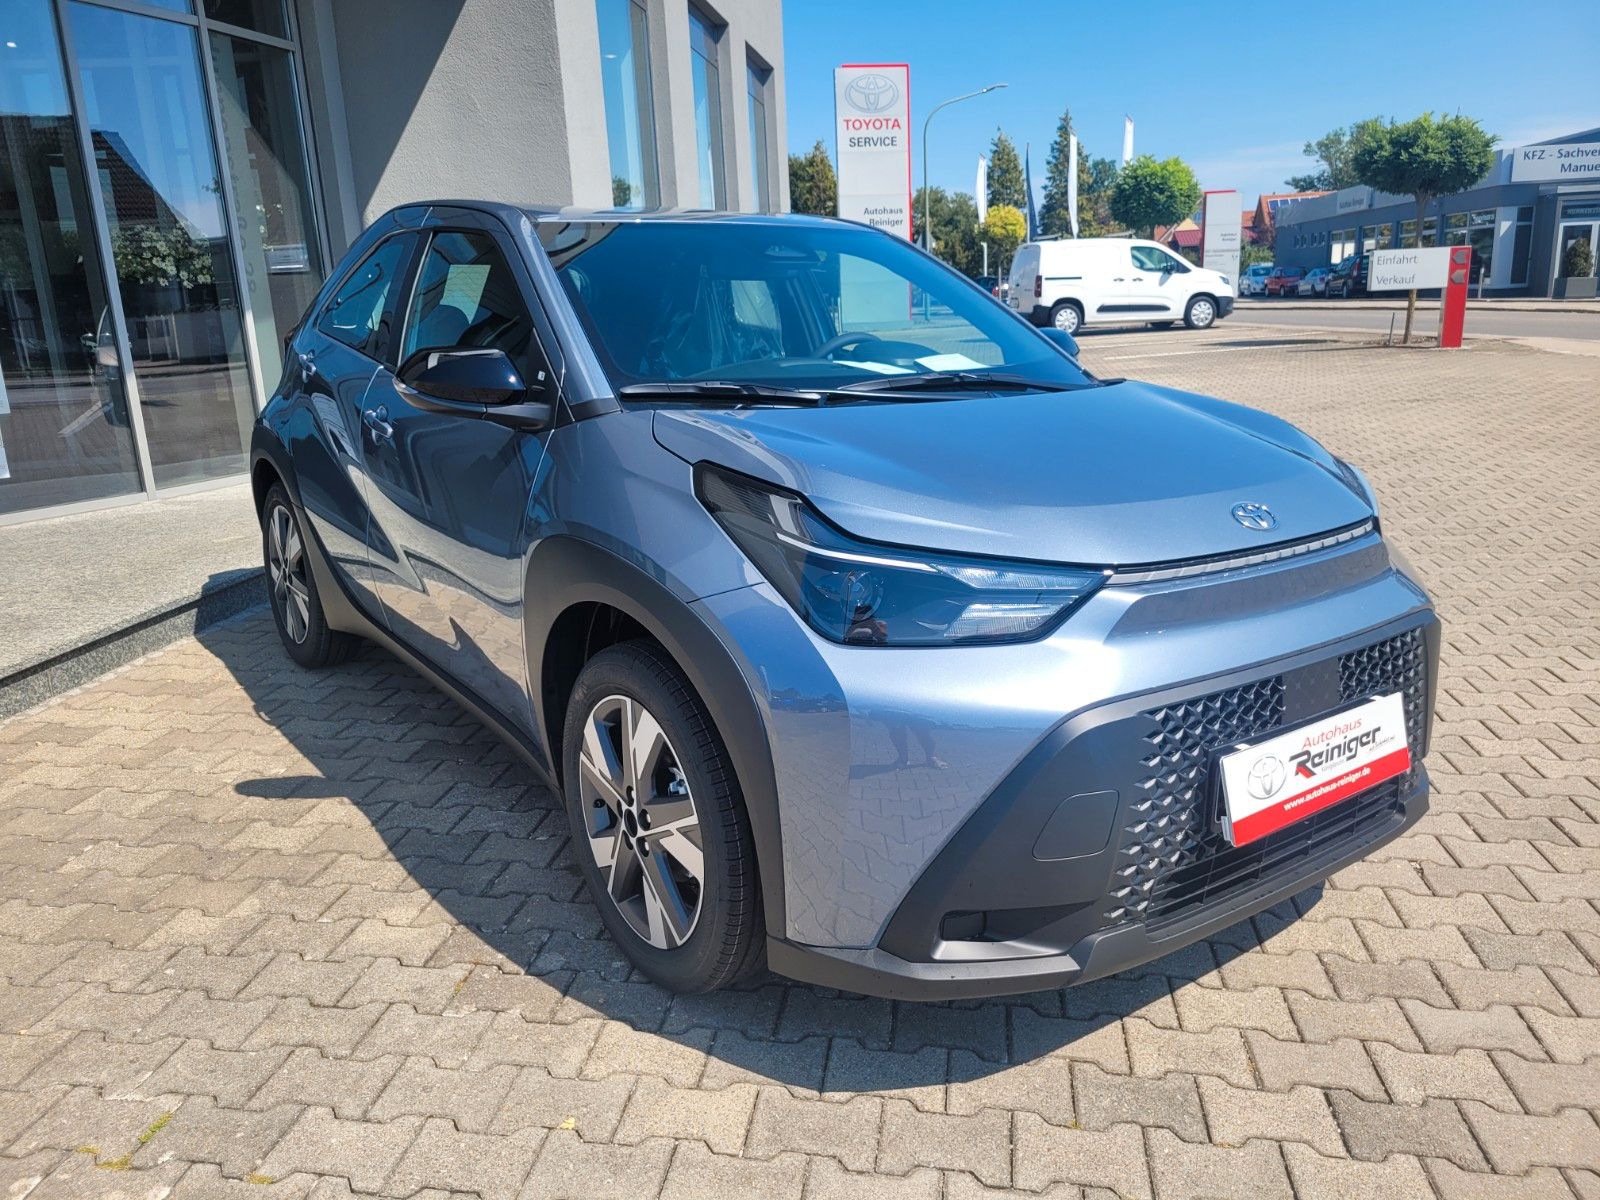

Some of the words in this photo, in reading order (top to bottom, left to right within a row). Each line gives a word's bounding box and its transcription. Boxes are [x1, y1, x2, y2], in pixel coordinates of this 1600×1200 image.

[843, 118, 901, 131] TOYOTA
[849, 136, 897, 148] SERVICE
[1523, 150, 1545, 161] KFZ
[864, 207, 903, 215] Autohaus
[869, 218, 903, 228] Reiniger
[1377, 254, 1418, 265] Einfahrt
[1376, 274, 1415, 286] Verkauf
[1302, 718, 1362, 750] Autohaus
[1289, 726, 1381, 779] Reiniger
[1284, 767, 1371, 811] www.autohaus-reiniger.de
